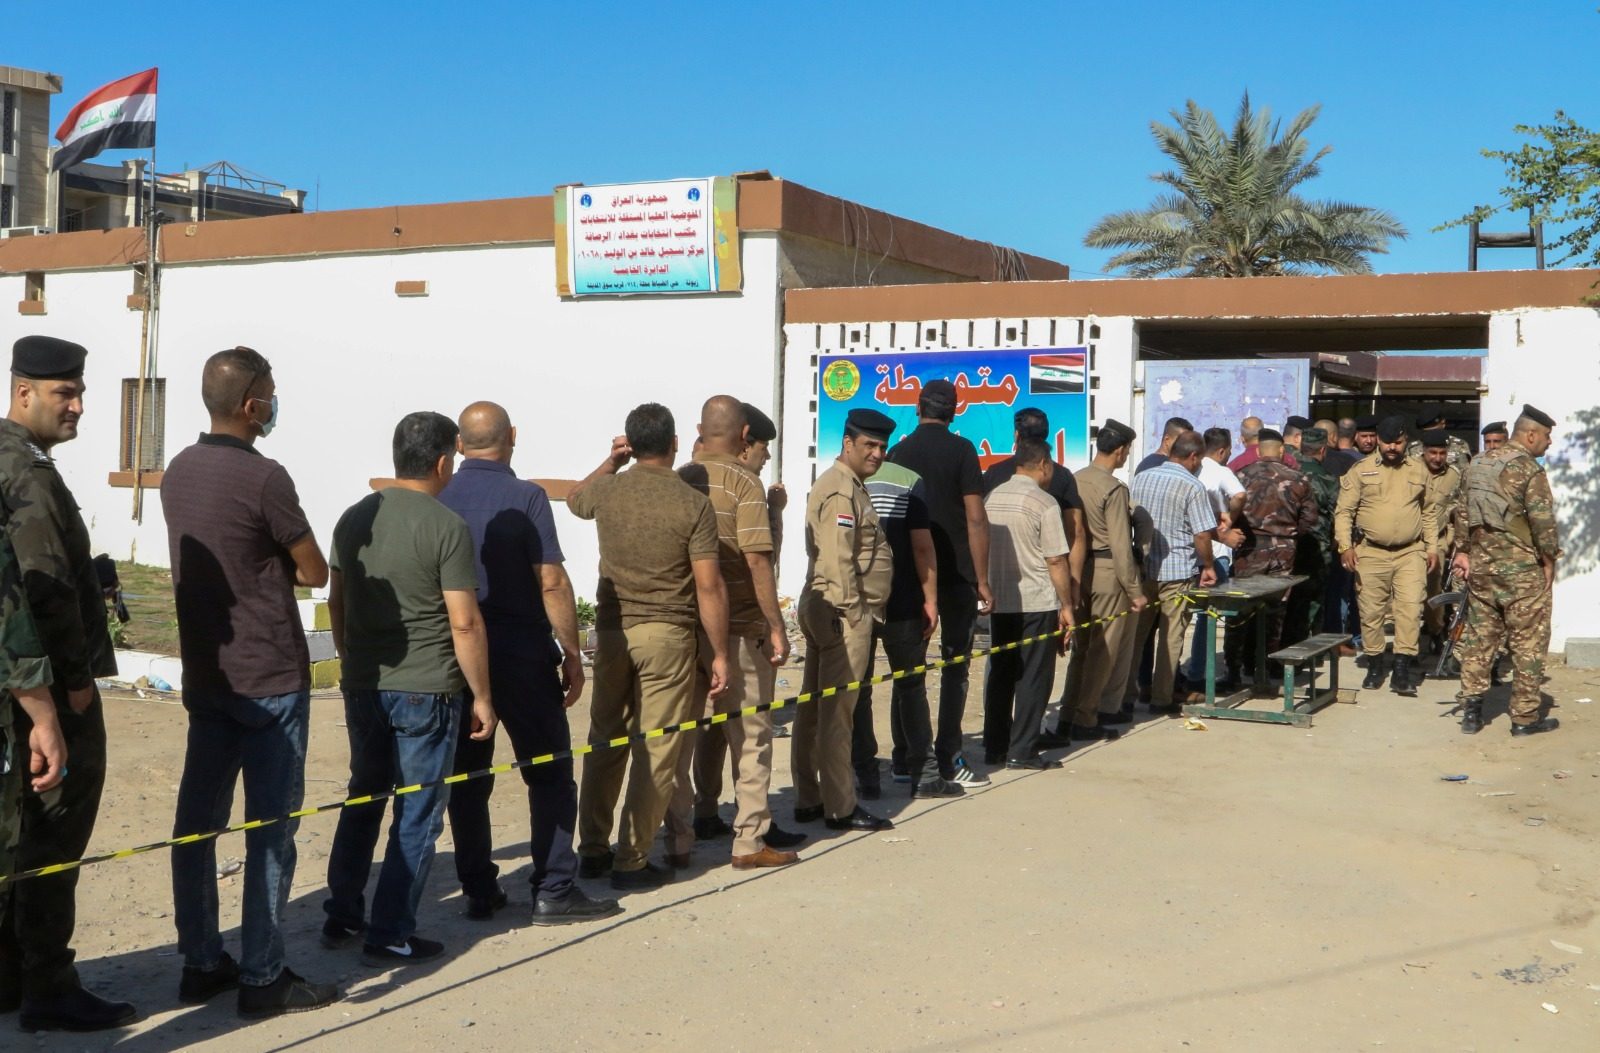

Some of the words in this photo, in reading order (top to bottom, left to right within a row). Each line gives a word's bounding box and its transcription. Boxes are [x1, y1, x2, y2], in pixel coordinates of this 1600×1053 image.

[611, 195, 634, 208] العراق
[636, 194, 668, 206] جمهورية
[580, 213, 616, 225] للانتخابات
[618, 212, 645, 223] المستقلة
[648, 211, 668, 223] العليا
[671, 209, 702, 222] المفوضية
[585, 232, 611, 243] الرصافة
[618, 231, 638, 241] بغداد
[641, 229, 671, 241] انتخابات
[674, 227, 696, 239] مكتب
[604, 248, 625, 260] الوليد
[628, 249, 637, 258] بن
[640, 247, 655, 257] خالد
[658, 246, 684, 259] تسجيل
[687, 245, 704, 257] مركز
[613, 265, 641, 275] الخامسة
[644, 264, 669, 276] الدائرة
[874, 363, 1020, 416] متوطة
